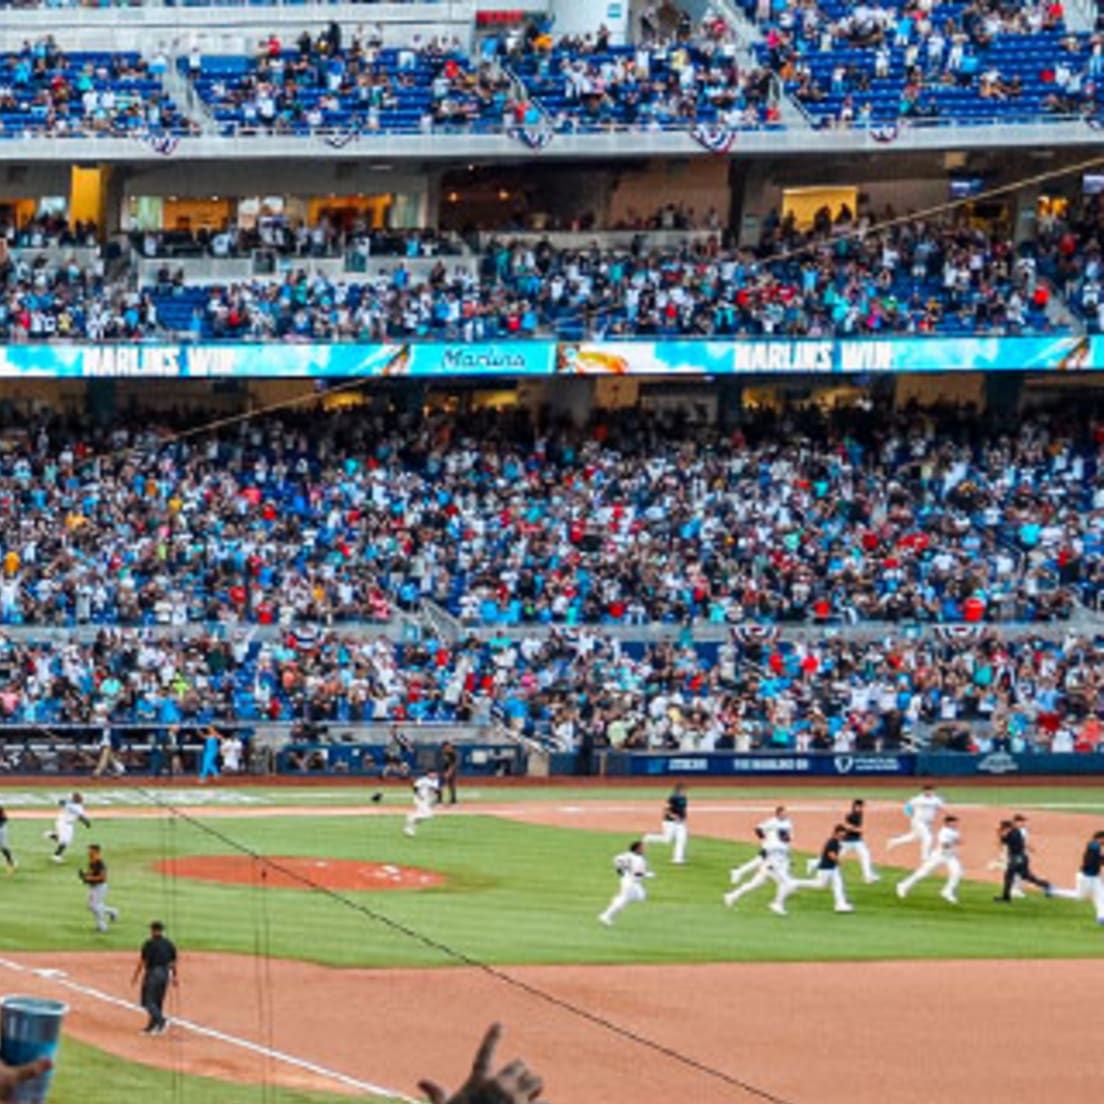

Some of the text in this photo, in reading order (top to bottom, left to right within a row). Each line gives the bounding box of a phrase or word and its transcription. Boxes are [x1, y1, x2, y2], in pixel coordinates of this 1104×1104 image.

[83, 345, 180, 376] MARLINS
[441, 346, 526, 371] Marlins
[735, 340, 891, 371] MARLINS WIN
